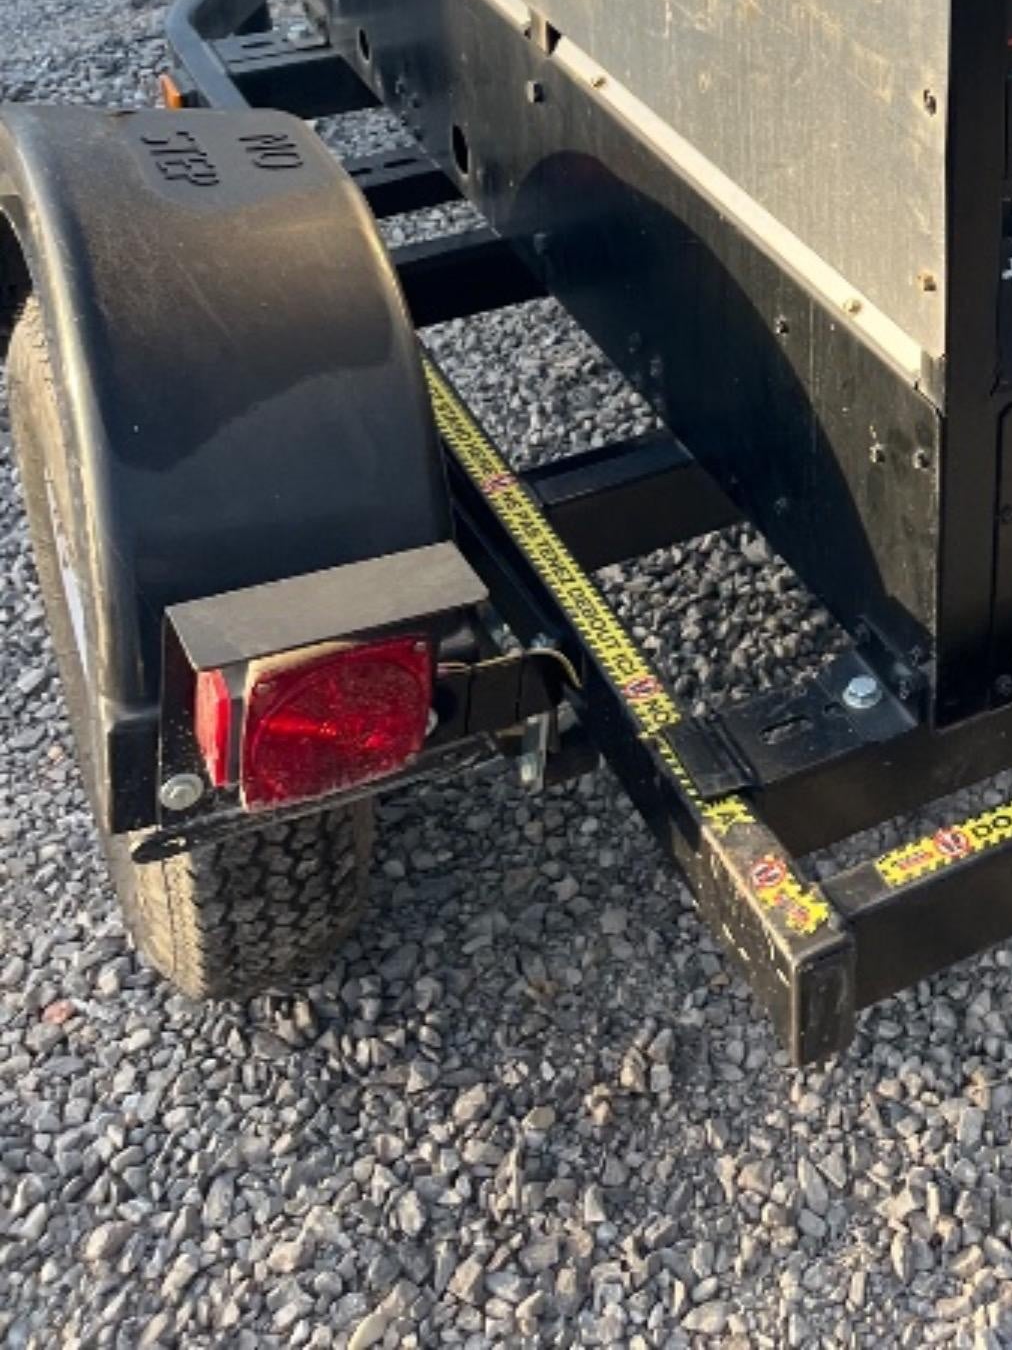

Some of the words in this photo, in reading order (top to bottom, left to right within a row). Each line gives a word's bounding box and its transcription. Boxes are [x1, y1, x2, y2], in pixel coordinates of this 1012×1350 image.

[139, 130, 221, 187] STEP
[238, 133, 304, 171] NO
[566, 587, 623, 649] DEBOUT
[971, 814, 1012, 839] DO
